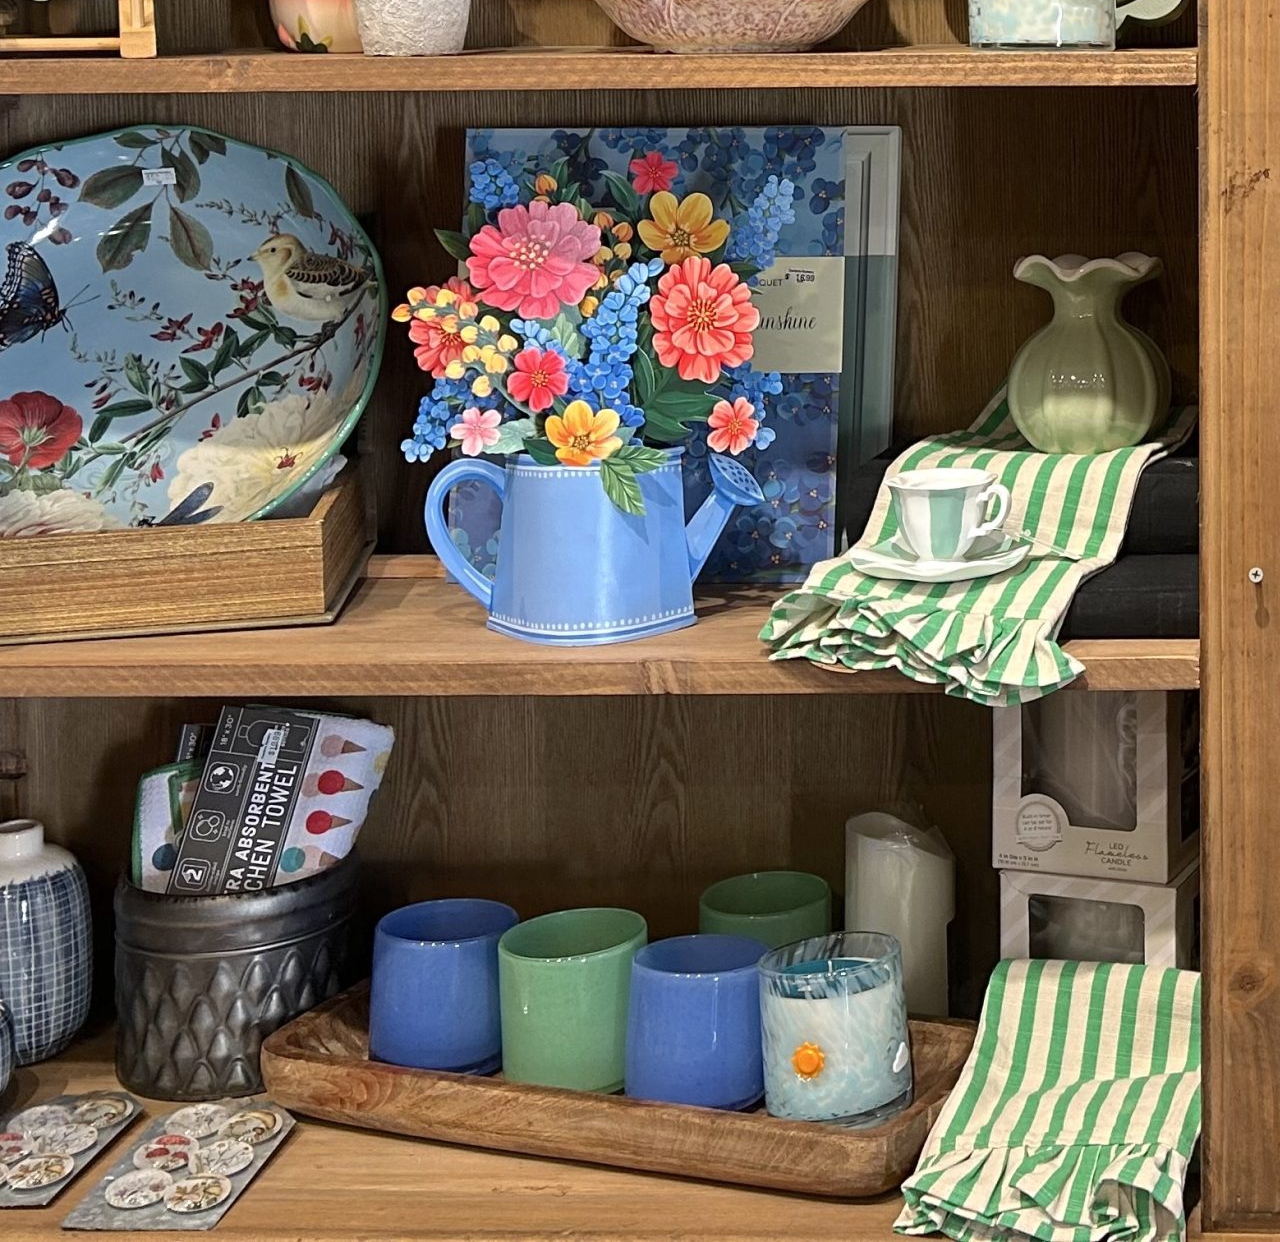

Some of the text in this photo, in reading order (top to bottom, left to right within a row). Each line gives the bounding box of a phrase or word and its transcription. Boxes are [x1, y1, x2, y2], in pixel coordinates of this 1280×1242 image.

[759, 278, 783, 286] QUET
[758, 306, 816, 330] unshine
[235, 762, 276, 861] ABSORBENT
[243, 766, 297, 891] CHEN TOWEL
[1109, 842, 1124, 850] LED
[1100, 858, 1132, 867] CANDLE
